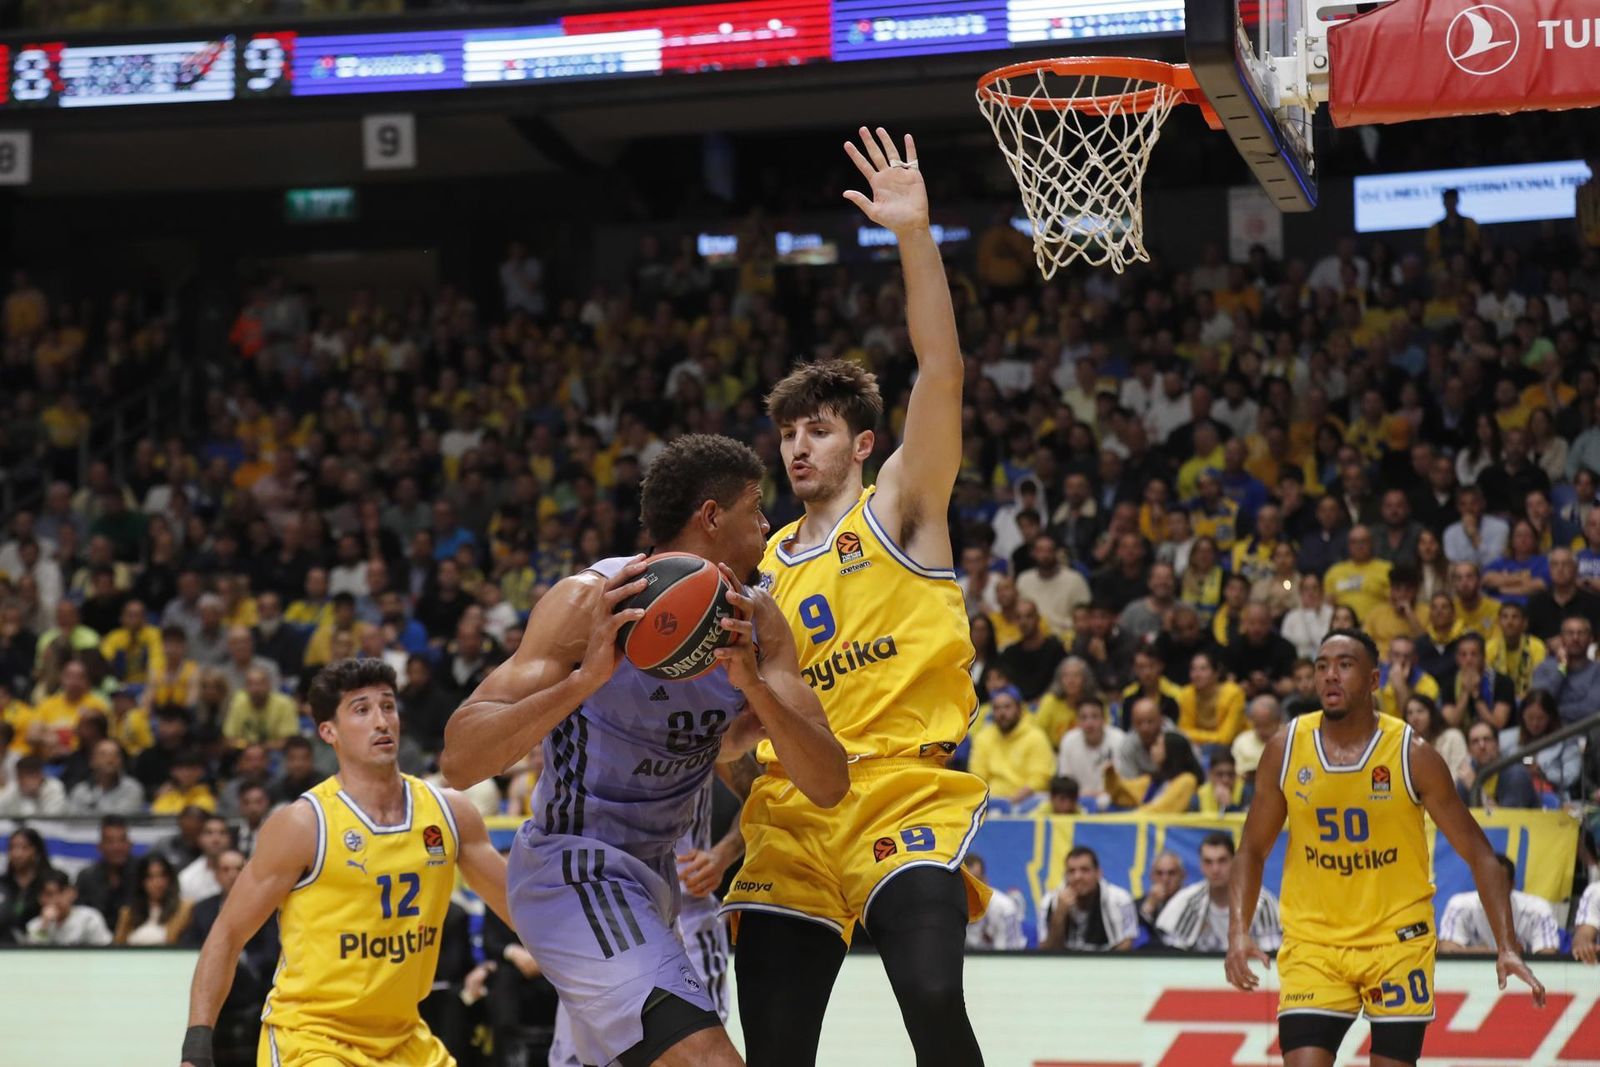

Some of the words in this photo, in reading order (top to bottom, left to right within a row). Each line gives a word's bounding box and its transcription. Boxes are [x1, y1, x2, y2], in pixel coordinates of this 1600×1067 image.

[376, 124, 401, 158] 9
[798, 593, 837, 646] 9
[800, 635, 898, 691] aytika
[899, 825, 936, 852] 9
[1315, 807, 1369, 842] 50
[1305, 844, 1399, 876] Playtika
[376, 872, 421, 920] 12
[734, 879, 773, 892] Rapyd
[1382, 968, 1430, 1008] 50
